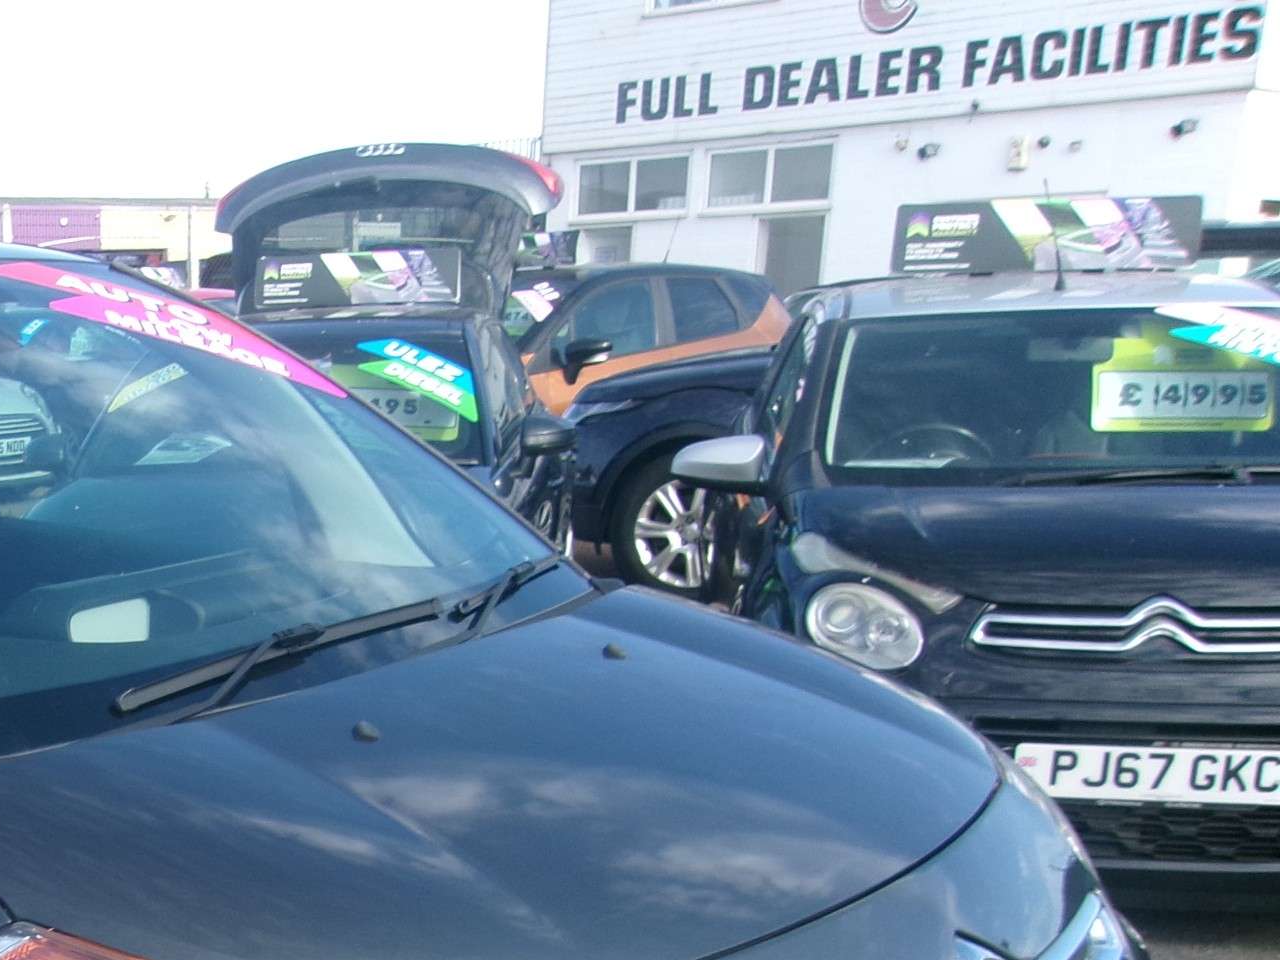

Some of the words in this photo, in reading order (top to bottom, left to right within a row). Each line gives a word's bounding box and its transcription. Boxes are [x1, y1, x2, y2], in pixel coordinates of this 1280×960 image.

[615, 72, 718, 124] FULL
[741, 45, 944, 113] DEALER
[962, 7, 1264, 88] FACILITIES
[55, 275, 210, 325] AUTO
[384, 341, 465, 382] ULEZ
[1049, 750, 1175, 790] PJ67
[1189, 754, 1280, 793] GKC
